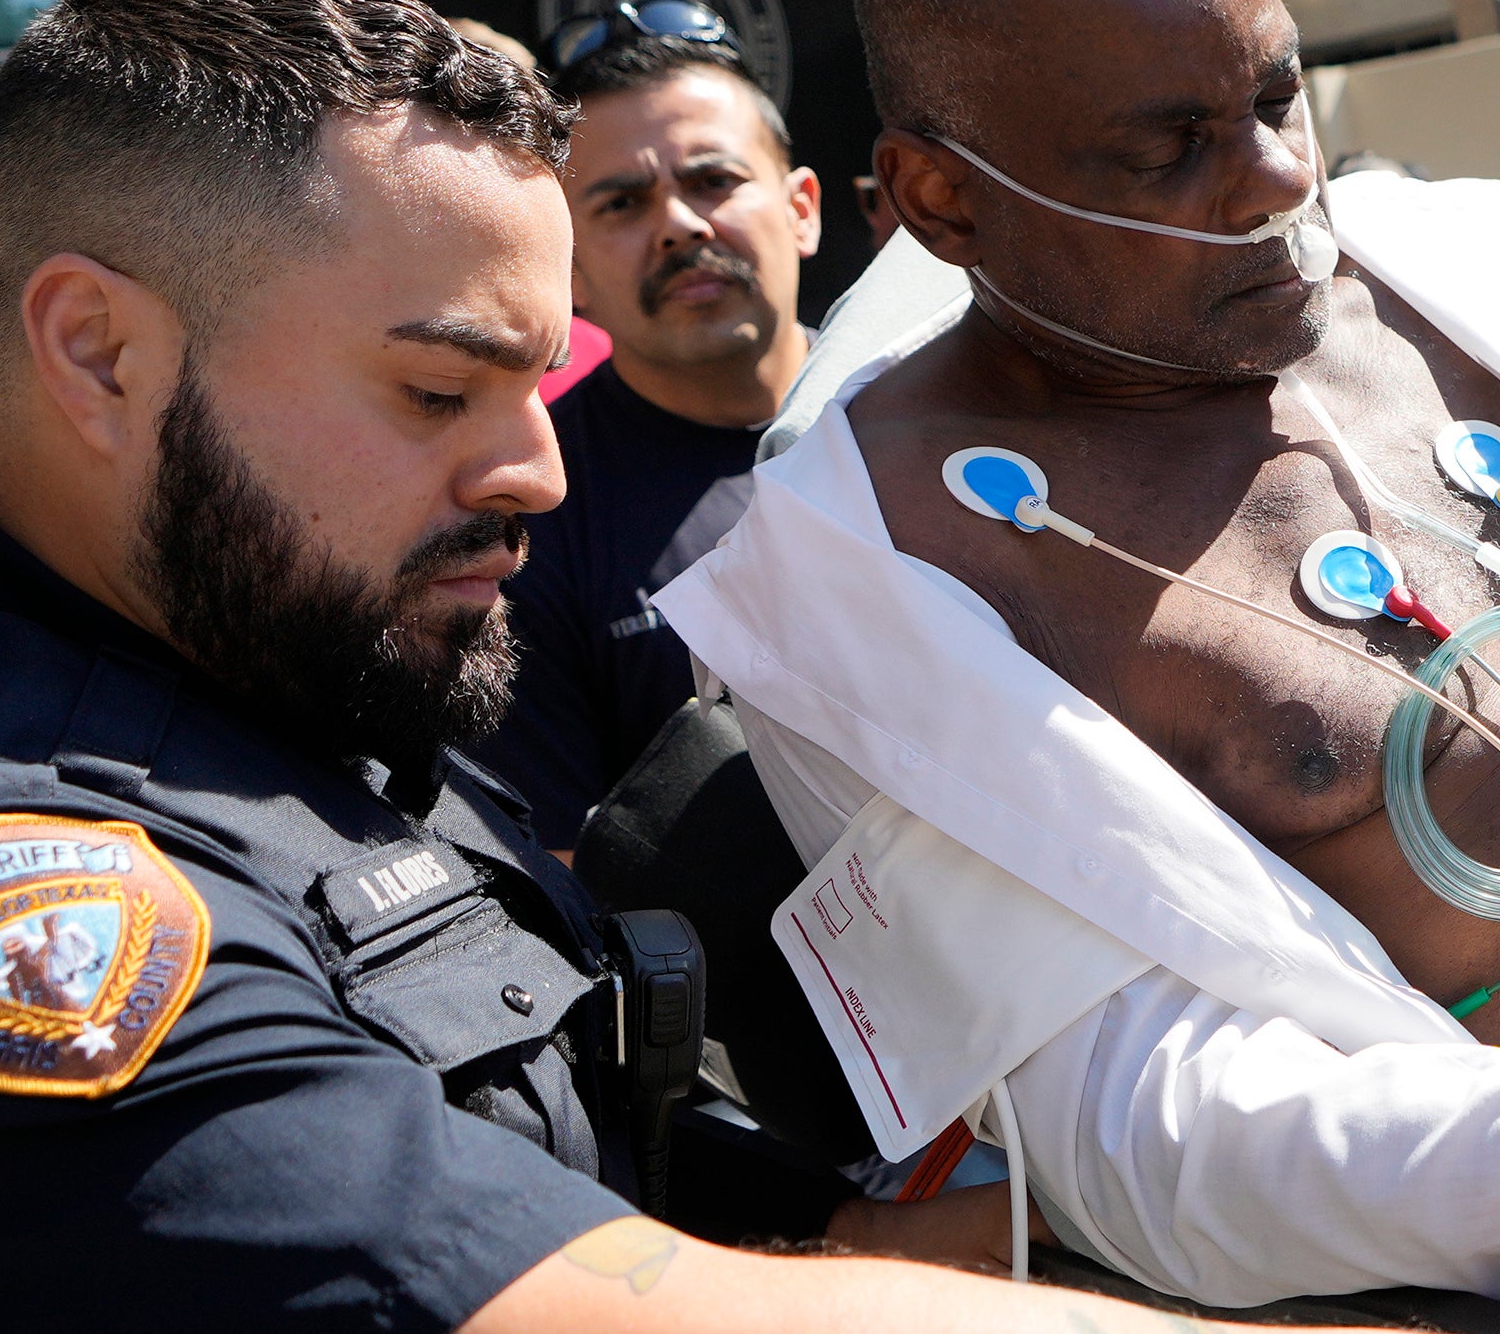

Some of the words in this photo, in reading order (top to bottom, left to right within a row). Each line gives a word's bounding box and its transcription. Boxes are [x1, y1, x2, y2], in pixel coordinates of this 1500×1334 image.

[35, 882, 109, 908] TEXAS
[854, 884, 874, 911] Rubber
[872, 909, 889, 930] Latex
[865, 884, 878, 902] with
[811, 897, 824, 921] Patient
[821, 914, 838, 941] Initials
[119, 923, 186, 1031] COUNTY
[845, 986, 865, 1018] INDEX
[859, 1015, 877, 1039] LINE
